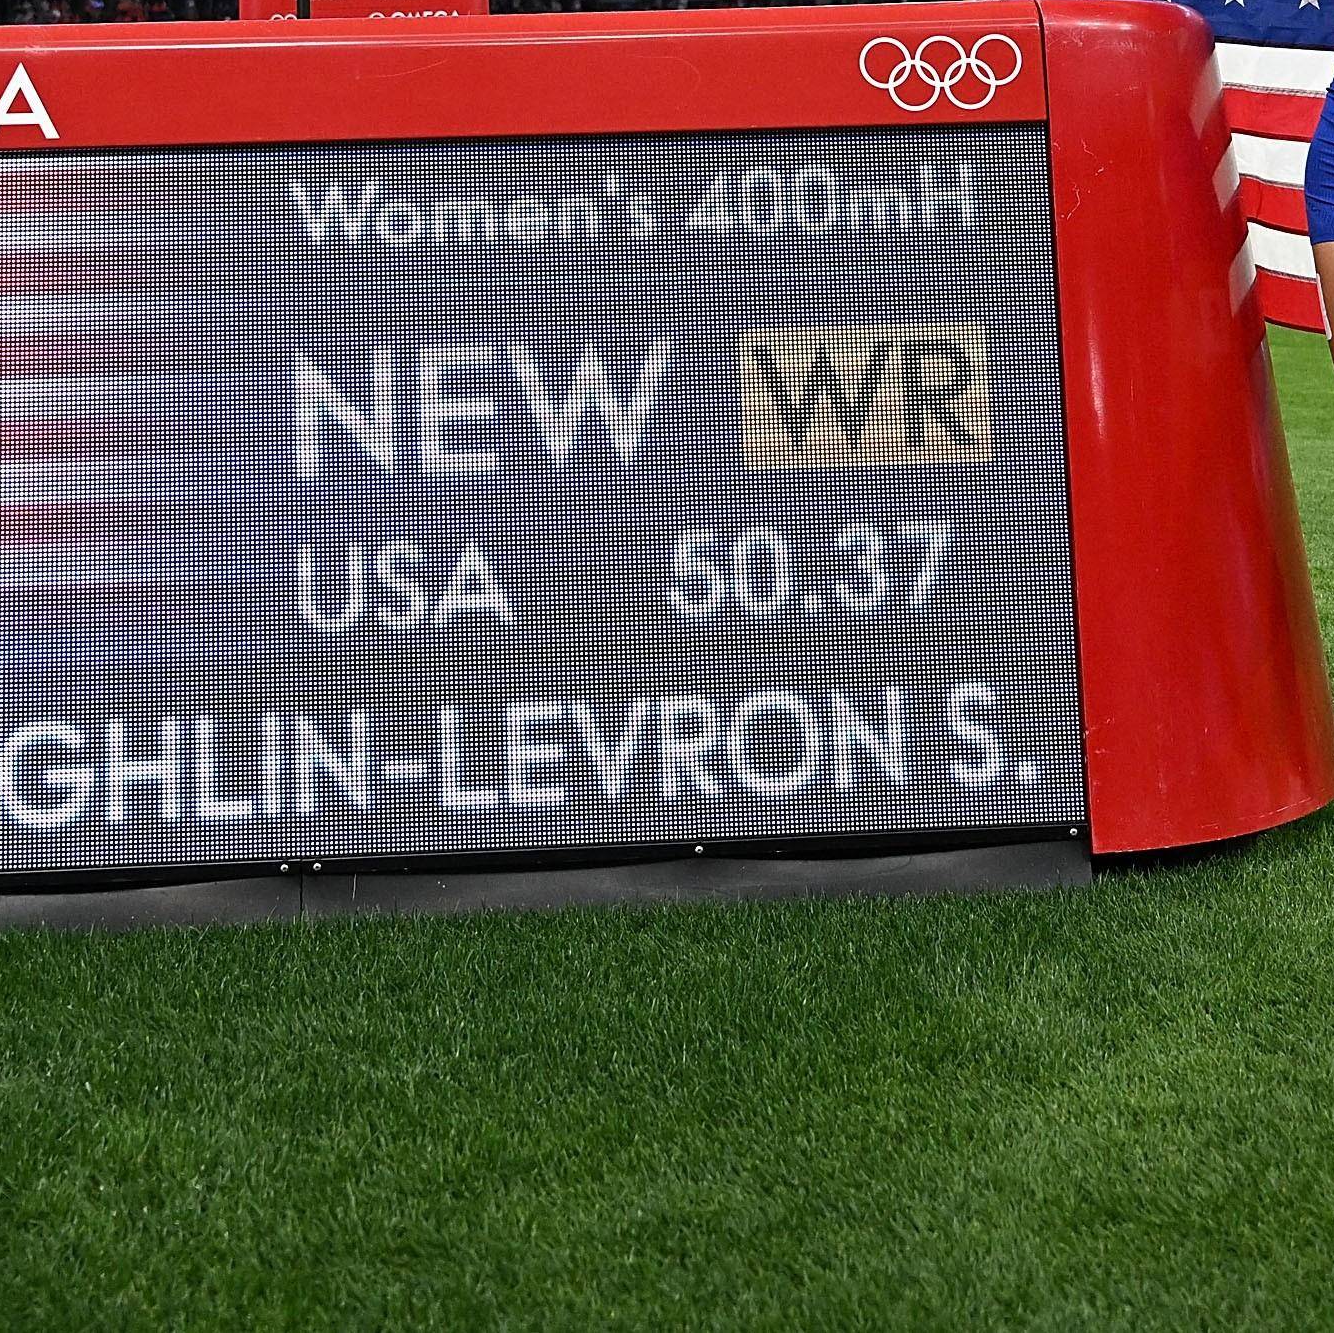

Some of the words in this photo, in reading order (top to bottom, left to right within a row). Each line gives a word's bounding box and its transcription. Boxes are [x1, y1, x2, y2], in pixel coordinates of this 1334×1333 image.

[288, 173, 654, 245] Women's
[681, 162, 980, 239] 400mH
[291, 337, 674, 480] NEW
[753, 338, 979, 451] WR
[295, 539, 517, 634] USA
[667, 521, 955, 623] 50.37
[948, 680, 1042, 786] S.
